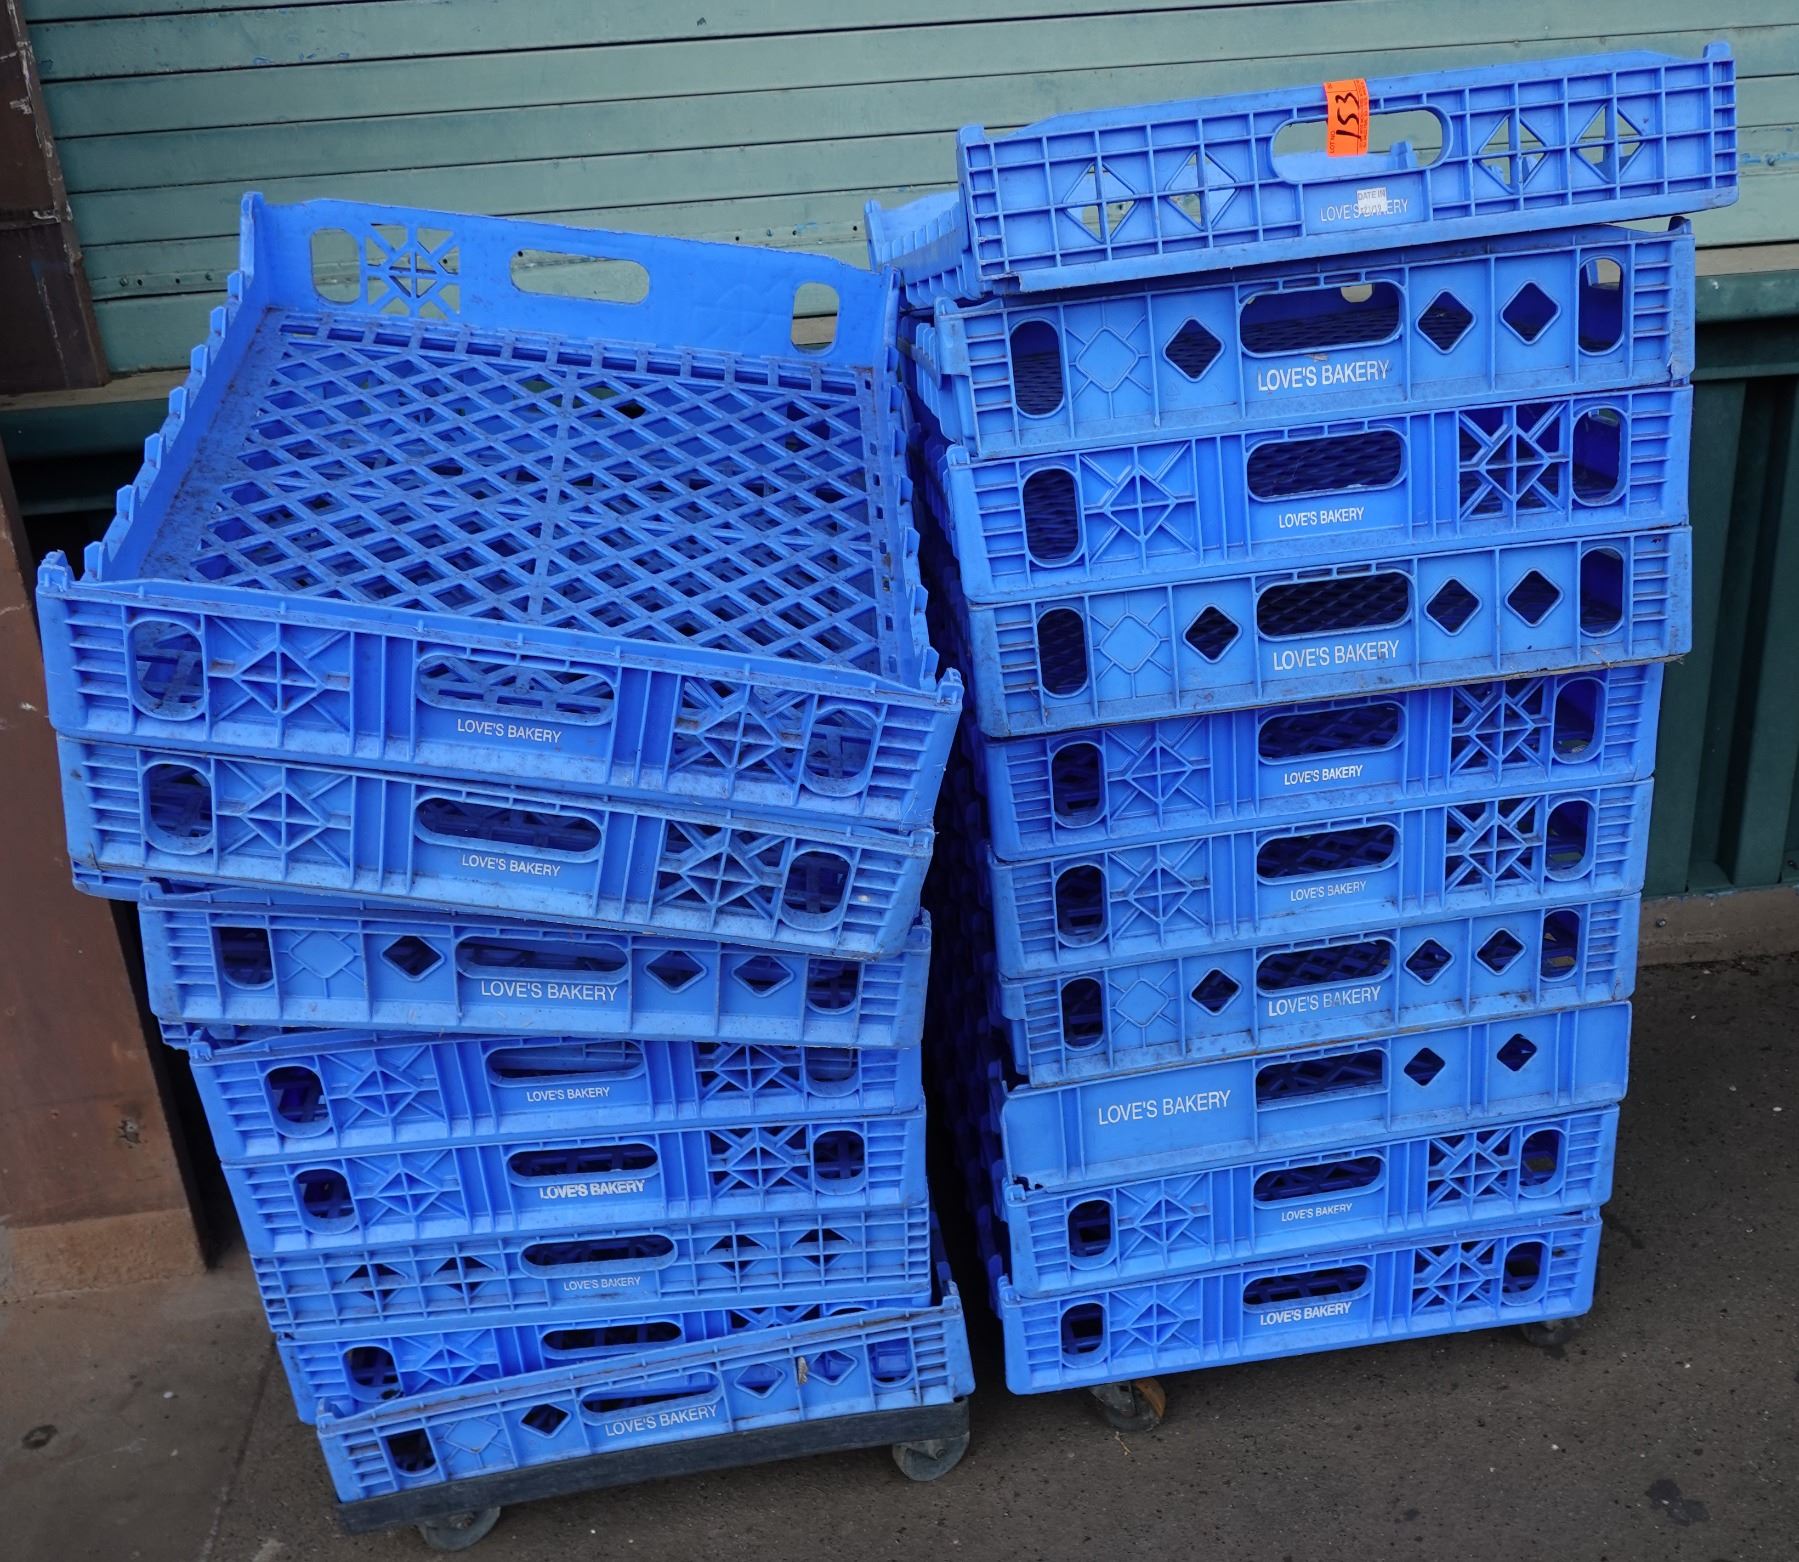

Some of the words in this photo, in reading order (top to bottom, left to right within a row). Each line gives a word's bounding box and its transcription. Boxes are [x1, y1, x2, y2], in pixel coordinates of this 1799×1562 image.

[1335, 92, 1361, 139] 153
[1357, 190, 1377, 201] DATE
[1320, 204, 1360, 222] LOVE'S
[1258, 367, 1316, 392] LOVE'S
[1322, 360, 1389, 385] BAKERY
[1279, 512, 1318, 529] LOVE'S
[1320, 507, 1364, 524] BAKERY
[1274, 647, 1329, 670] LOVE'S
[1335, 640, 1399, 663] BAKERY
[458, 718, 504, 736] LOVE'S
[508, 725, 562, 743] BAKERY
[1285, 770, 1320, 785] LOVE'S
[1322, 765, 1363, 781] BAKERY
[462, 854, 506, 870] LOVE'S
[509, 860, 561, 876] BAKERY
[1290, 887, 1324, 901] LOVE'S
[1327, 880, 1366, 896] BAKERY
[482, 979, 542, 998] LOVE'S
[548, 983, 617, 1000] BAKERY
[1268, 995, 1318, 1016] LOVE'S
[1324, 986, 1380, 1009] BAKERY
[527, 1090, 564, 1102] LOVE'S
[567, 1087, 610, 1099] BAKERY
[1099, 1100, 1157, 1124] LOVE'S
[1163, 1090, 1231, 1115] BAKERY
[540, 1184, 586, 1199] LOVE'S
[590, 1180, 645, 1196] BAKERY
[1282, 1209, 1314, 1222] LOVE'S
[1316, 1203, 1353, 1217] BAKERY
[563, 1280, 599, 1291] LOVE'S
[601, 1276, 640, 1289] BAKERY
[1261, 1309, 1301, 1325] LOVE'S
[1304, 1302, 1351, 1319] BAKERY
[606, 1416, 656, 1437] LOVE'S
[661, 1404, 717, 1426] BAKERY
